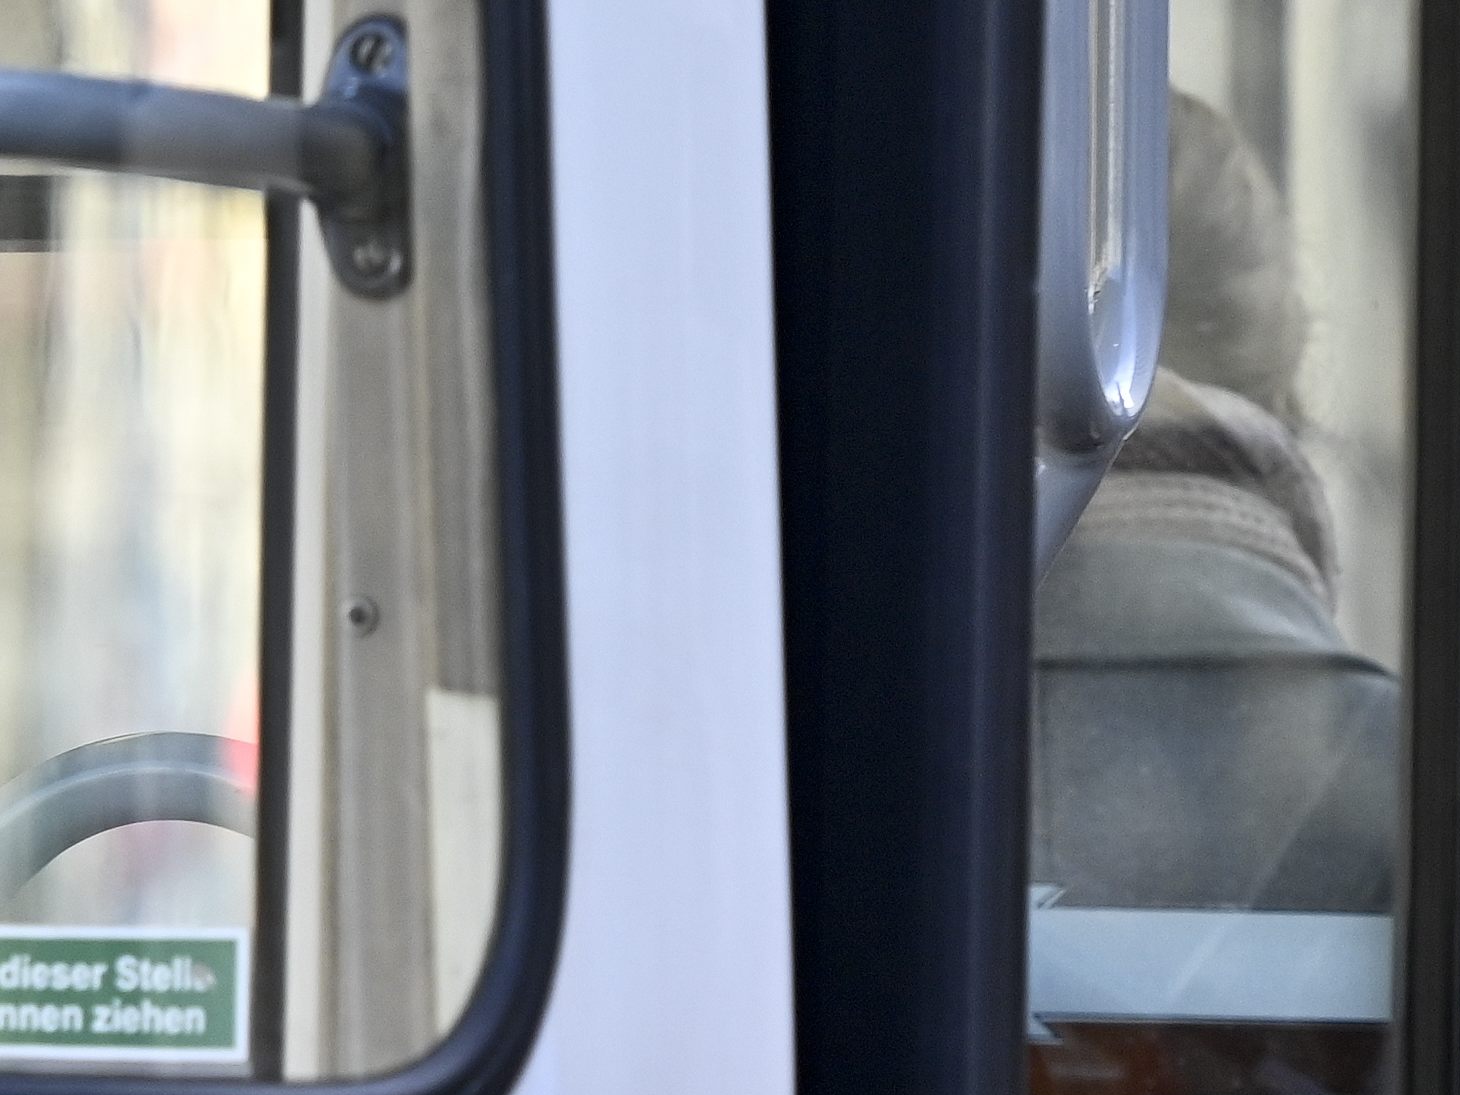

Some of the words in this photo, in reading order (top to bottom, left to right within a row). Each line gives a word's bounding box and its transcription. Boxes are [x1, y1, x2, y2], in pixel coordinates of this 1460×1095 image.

[0, 954, 107, 990] dieser
[0, 1003, 83, 1032] nnen
[91, 999, 206, 1034] ziehen
